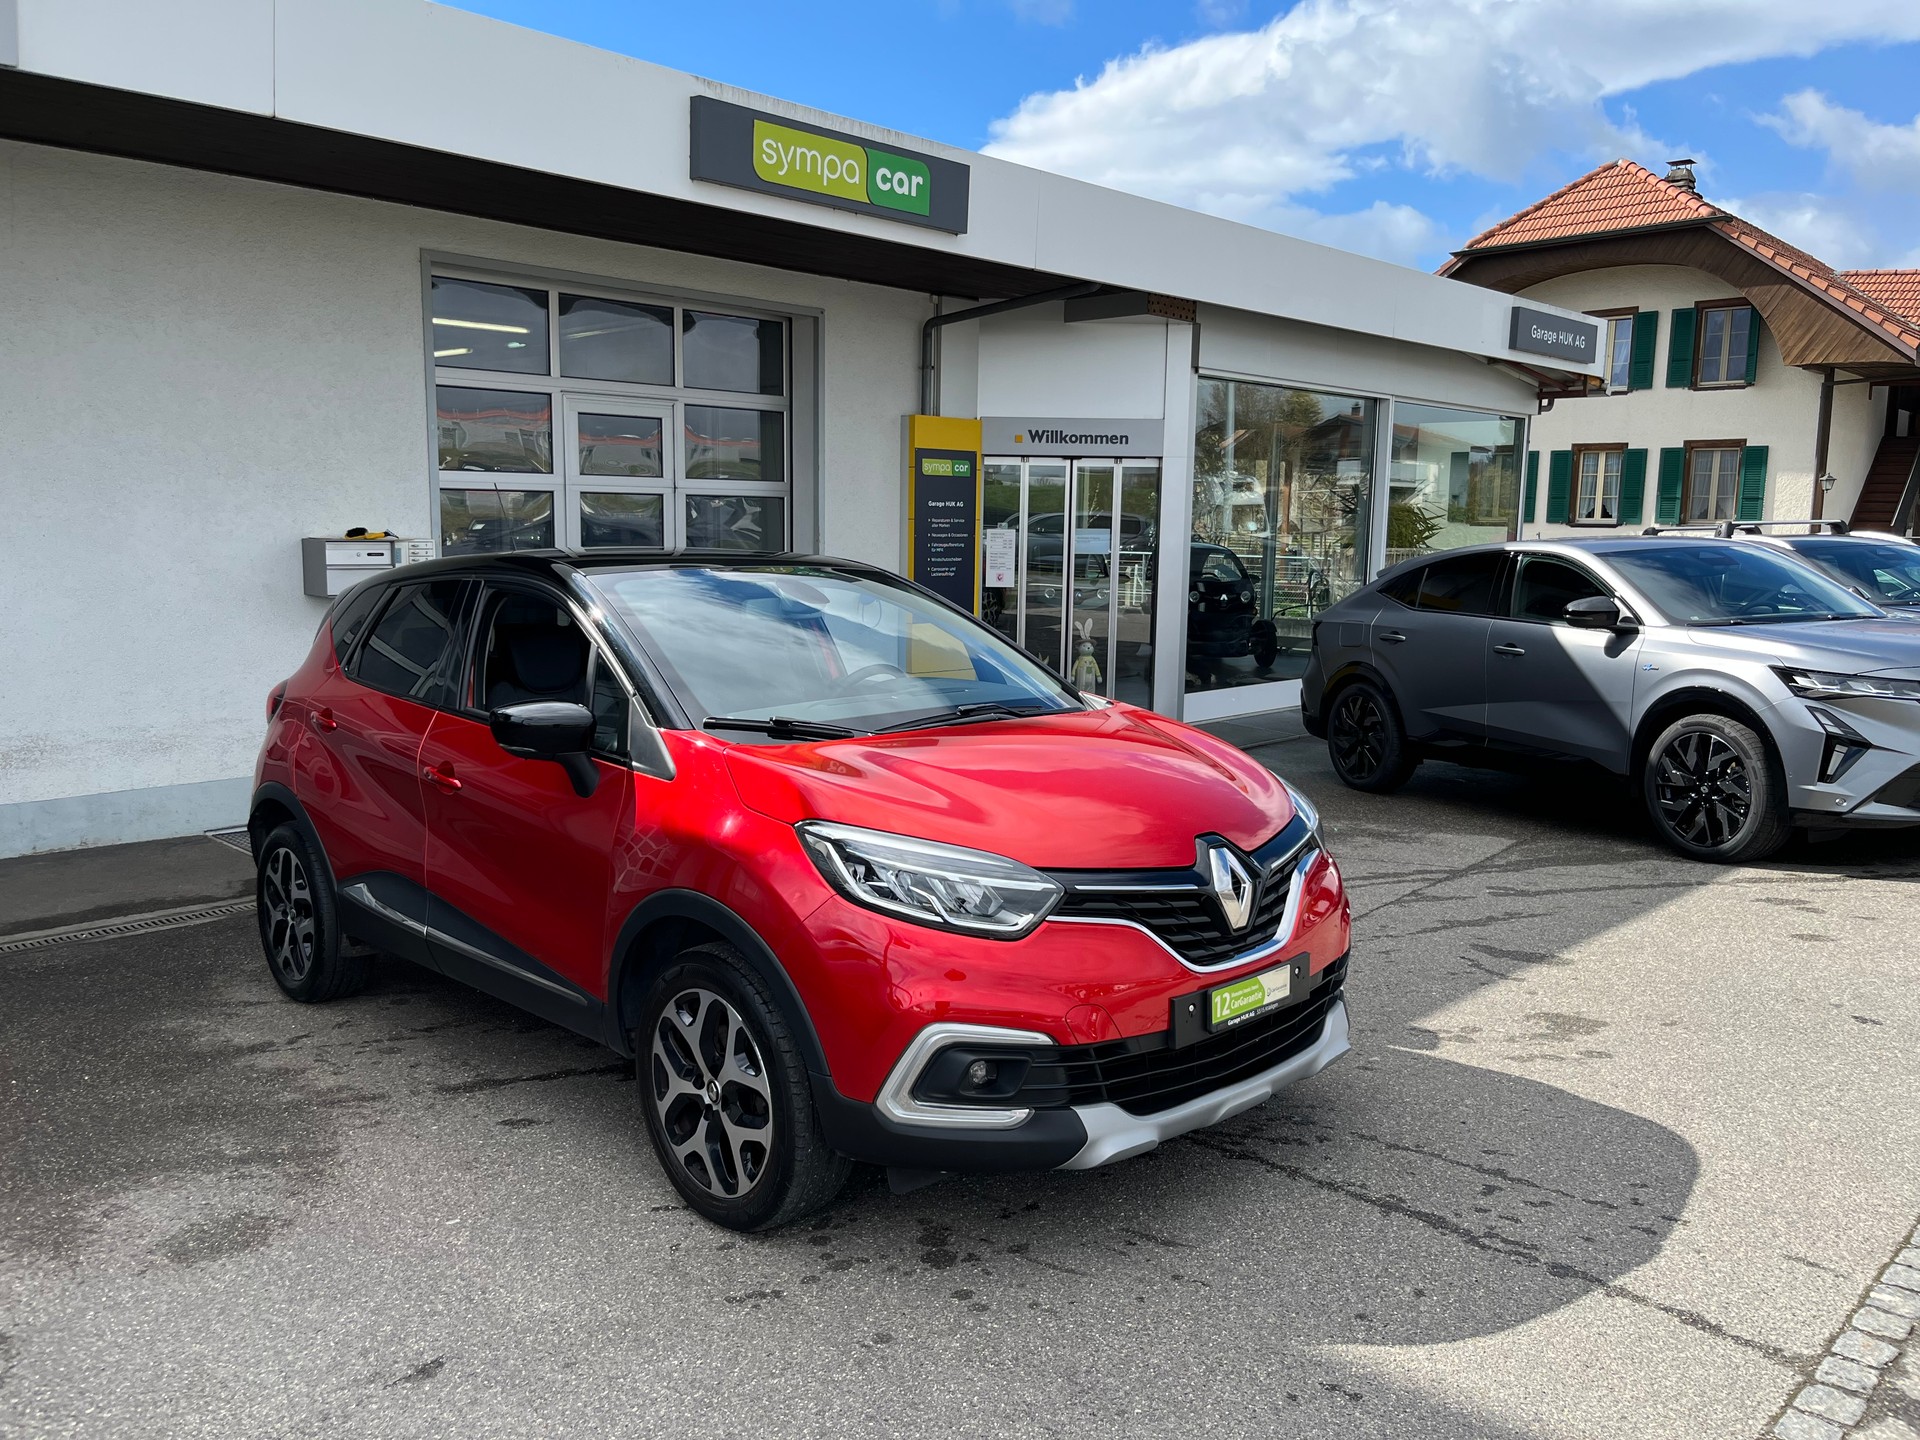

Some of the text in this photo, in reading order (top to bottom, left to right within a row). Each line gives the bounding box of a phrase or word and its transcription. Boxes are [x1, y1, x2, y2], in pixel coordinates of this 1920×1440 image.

[762, 138, 923, 197] sympa car
[1531, 325, 1586, 349] Garage HUK AG
[1028, 429, 1129, 445] Willkommen
[924, 463, 969, 473] sympa car
[1214, 992, 1230, 1018] 12
[1231, 991, 1263, 1009] CarGarantie
[1227, 1017, 1241, 1026] Garage
